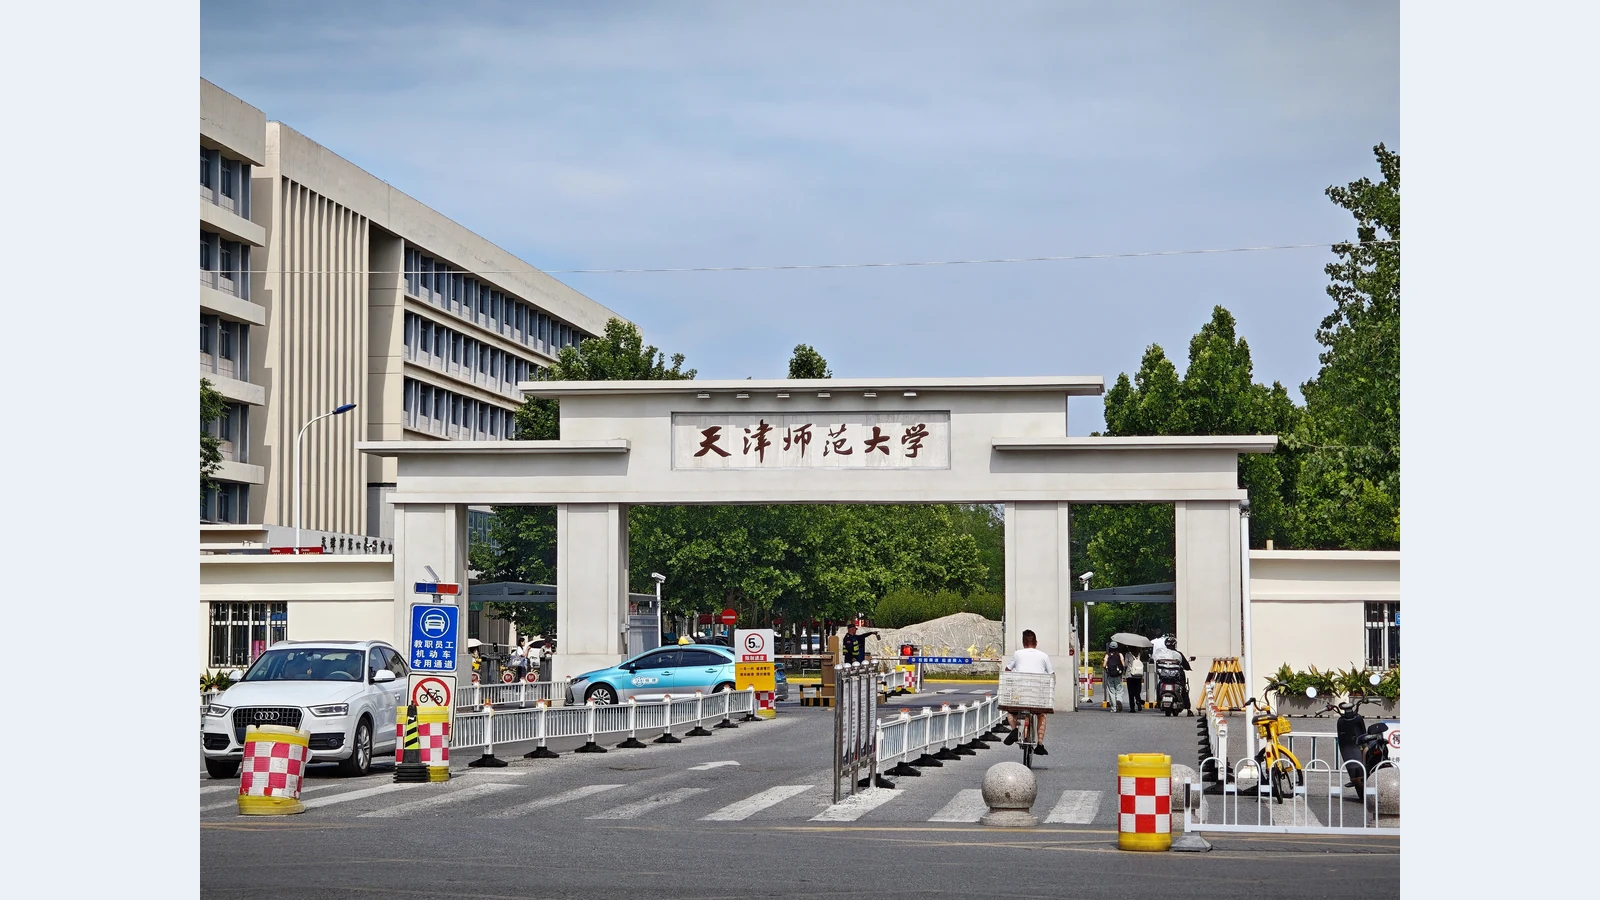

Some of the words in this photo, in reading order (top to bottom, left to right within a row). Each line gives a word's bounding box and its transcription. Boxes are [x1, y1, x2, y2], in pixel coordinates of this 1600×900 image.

[694, 419, 929, 463] 天津师范大学
[414, 640, 454, 648] 教职员工
[416, 650, 451, 659] 机动车
[413, 659, 452, 668] 专用通道
